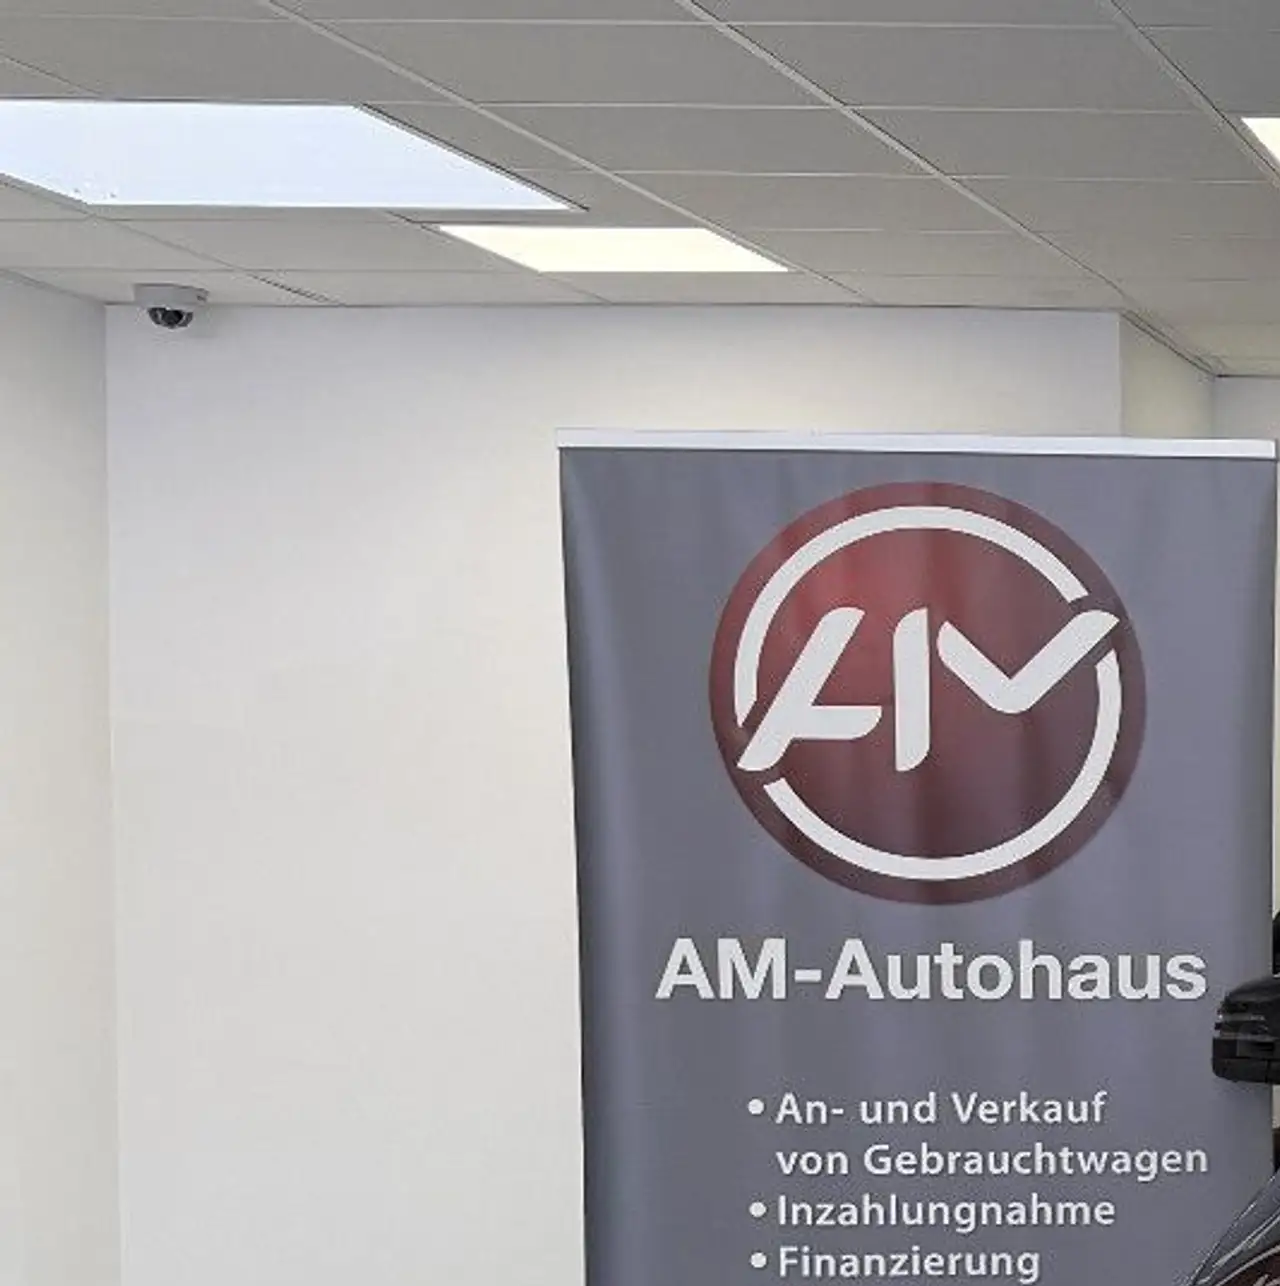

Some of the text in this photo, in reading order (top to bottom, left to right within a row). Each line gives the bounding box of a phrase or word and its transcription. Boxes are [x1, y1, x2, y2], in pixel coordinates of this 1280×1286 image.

[655, 936, 1208, 1002] AM-Autohaus
[775, 1091, 1109, 1125] An- und Verkauf
[775, 1142, 1209, 1183] von Gebrauchtwagen
[777, 1193, 1117, 1234] Inzahlungnahme
[779, 1245, 1041, 1285] Finanzierung
